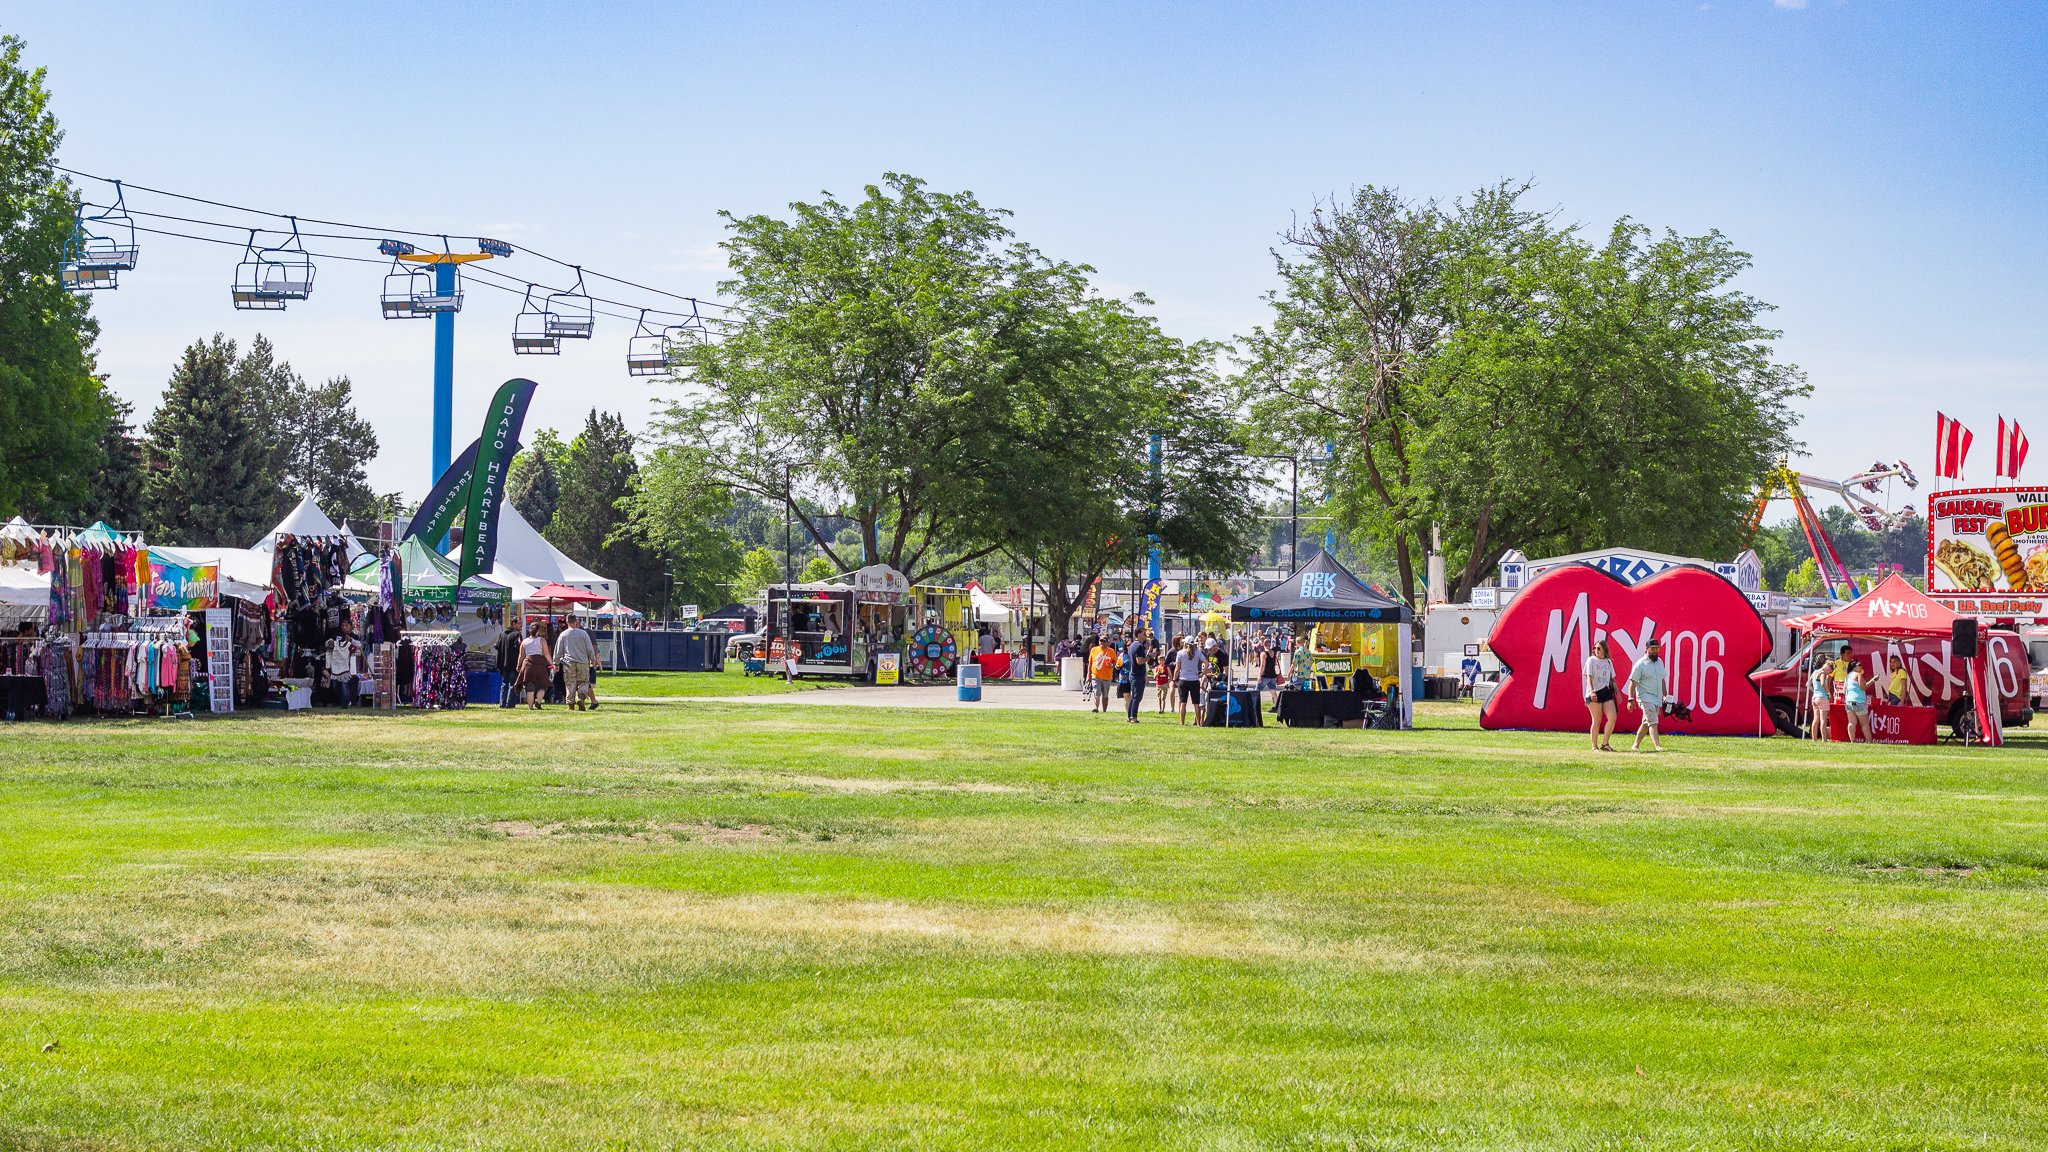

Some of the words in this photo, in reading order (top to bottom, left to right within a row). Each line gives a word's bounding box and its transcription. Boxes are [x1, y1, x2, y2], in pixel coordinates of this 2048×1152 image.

[493, 393, 515, 450] IDAHO
[426, 470, 472, 533] HEARTBEAT
[1936, 499, 2003, 518] SAUSAGE
[475, 461, 500, 566] HEARTBEAT
[1953, 517, 1987, 534] FEST
[150, 571, 176, 598] Face
[181, 575, 216, 602] Painting
[1300, 585, 1336, 598] BOX
[1264, 608, 1366, 619] rockboxfitness.com
[1980, 600, 2009, 612] Beef
[2010, 600, 2043, 614] Patty
[1324, 660, 1351, 672] LEMONADE
